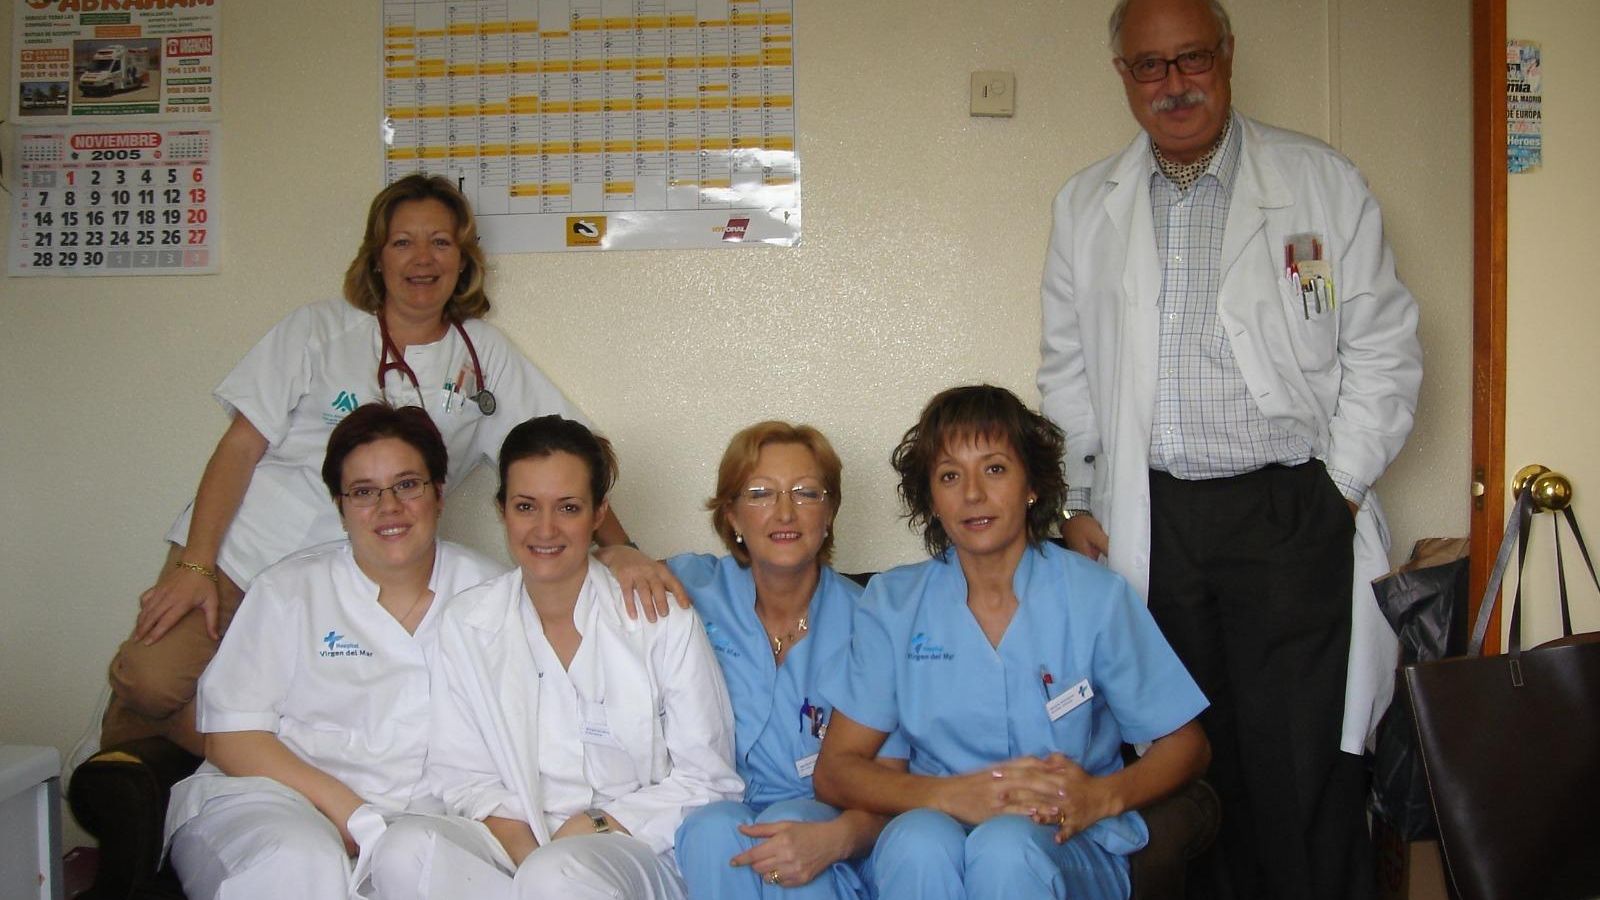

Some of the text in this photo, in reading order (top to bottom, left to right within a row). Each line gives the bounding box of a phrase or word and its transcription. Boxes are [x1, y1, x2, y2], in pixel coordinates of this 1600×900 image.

[1520, 95, 1541, 104] MADRID
[1516, 110, 1542, 119] EUROPA
[75, 134, 157, 149] NOVIEMBRE
[91, 150, 141, 161] 2005
[67, 171, 74, 185] 1
[92, 171, 100, 185] 2
[117, 170, 125, 184] 3
[142, 170, 151, 183] 4
[168, 169, 176, 183] 5
[193, 168, 202, 182] 6
[39, 189, 205, 206] 7 8 9 10 11 12 13
[35, 209, 207, 226] 14 15 16 17 18 19 20
[36, 230, 206, 246] 21 22 23 24 25 26 27
[33, 252, 52, 266] 28
[59, 252, 77, 266] 29
[84, 252, 103, 265] 30
[140, 254, 149, 264] 2
